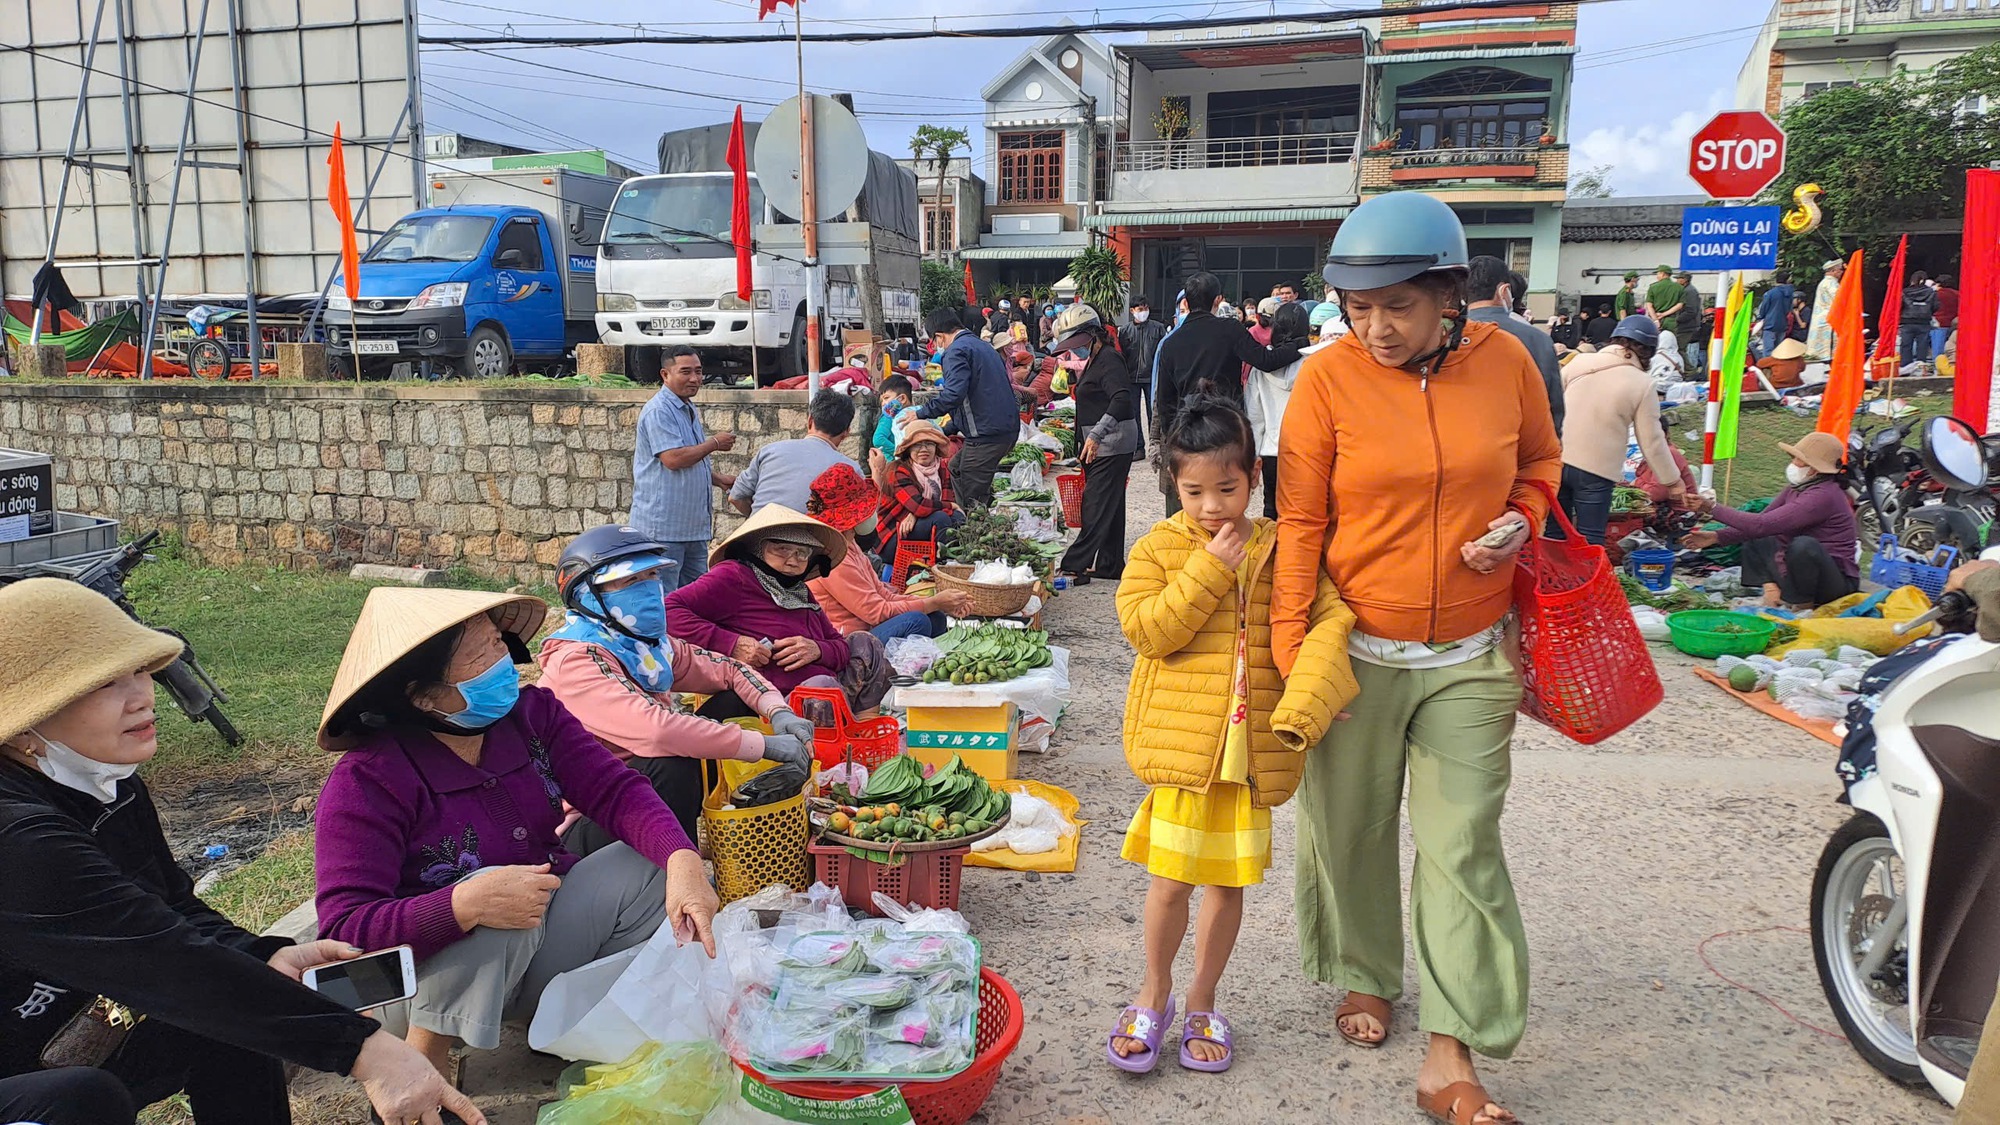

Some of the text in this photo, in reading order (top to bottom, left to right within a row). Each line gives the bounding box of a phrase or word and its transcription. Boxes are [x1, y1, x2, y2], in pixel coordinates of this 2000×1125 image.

[1697, 138, 1777, 171] STOP
[1690, 217, 1771, 236] DỪNG LẠI
[1687, 238, 1773, 257] QUAN SÁT
[571, 257, 596, 269] THAC
[358, 343, 395, 352] 7C-253.83
[8, 495, 37, 514] động
[937, 734, 999, 747] マルタケ
[818, 1110, 837, 1120] HEO
[880, 1100, 903, 1118] CON
[858, 1097, 885, 1110] DURA
